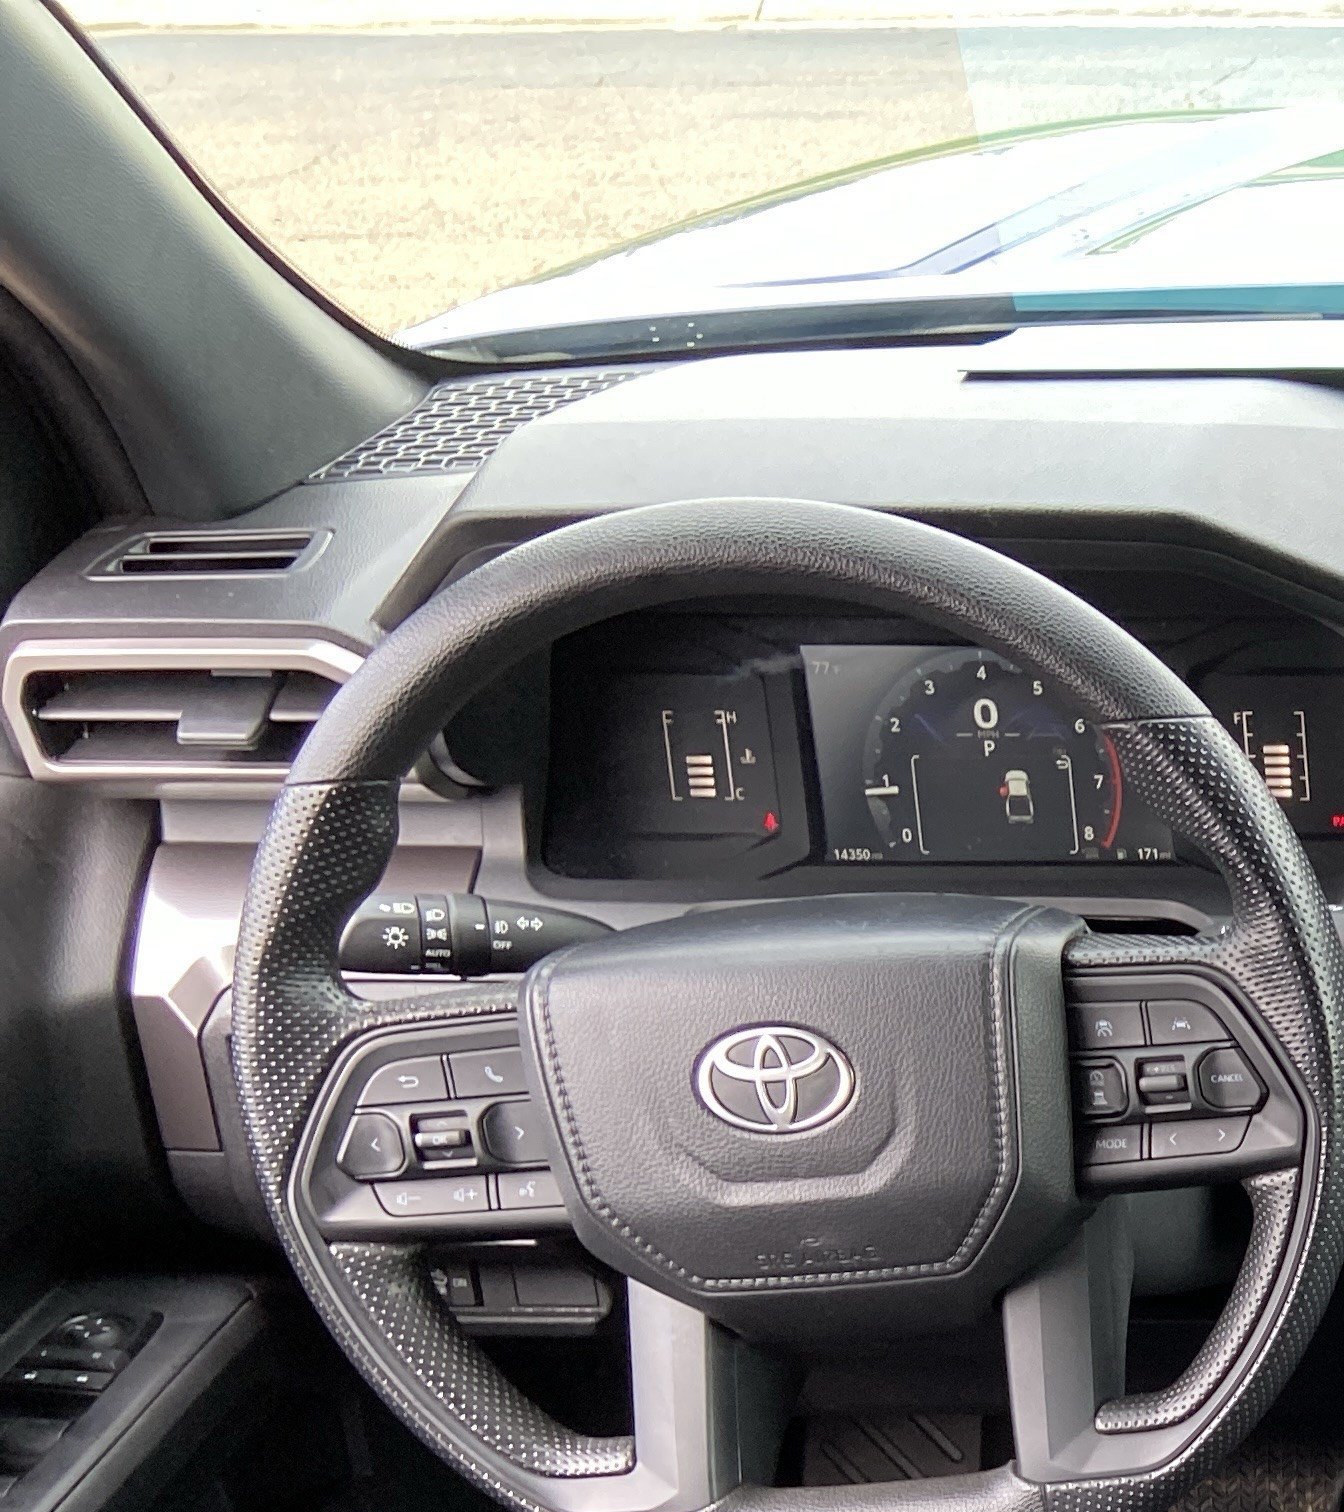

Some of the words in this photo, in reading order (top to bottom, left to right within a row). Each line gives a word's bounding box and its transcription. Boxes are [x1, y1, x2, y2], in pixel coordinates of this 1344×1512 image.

[976, 665, 987, 680] 4
[924, 680, 935, 695] 3
[1032, 680, 1043, 695] 5
[973, 698, 999, 729] 0
[890, 717, 901, 732] 2
[1074, 718, 1085, 733] 6
[984, 740, 995, 757] P
[882, 774, 889, 787] 1
[1093, 774, 1104, 789] 7
[902, 827, 912, 843] 0
[1084, 826, 1094, 840] 8
[834, 849, 870, 861] 14350
[1138, 848, 1159, 860] 171
[1211, 1074, 1243, 1083] CANCEL
[1096, 1138, 1127, 1149] MODE
